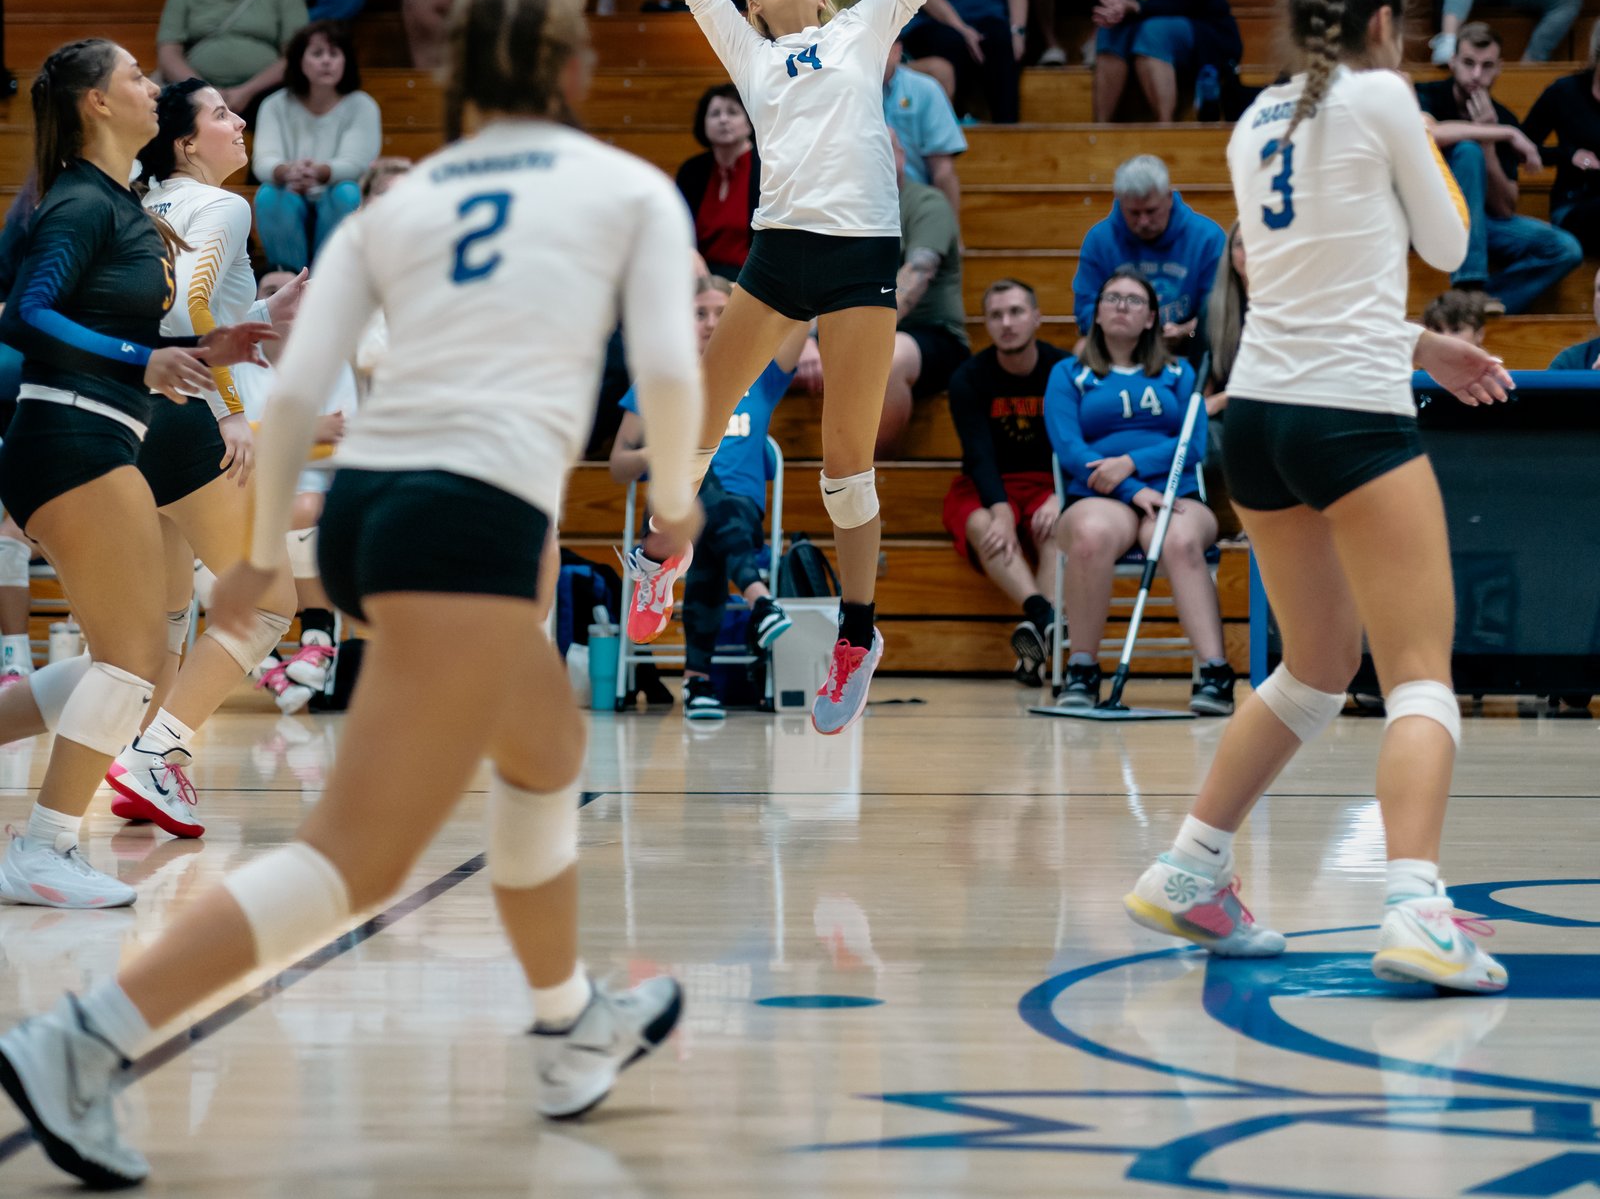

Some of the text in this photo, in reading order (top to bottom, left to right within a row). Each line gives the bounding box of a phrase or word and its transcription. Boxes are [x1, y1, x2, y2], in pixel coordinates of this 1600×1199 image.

[785, 43, 822, 78] 14
[1260, 138, 1295, 230] 3
[451, 190, 514, 285] 2
[1119, 385, 1163, 418] 14
